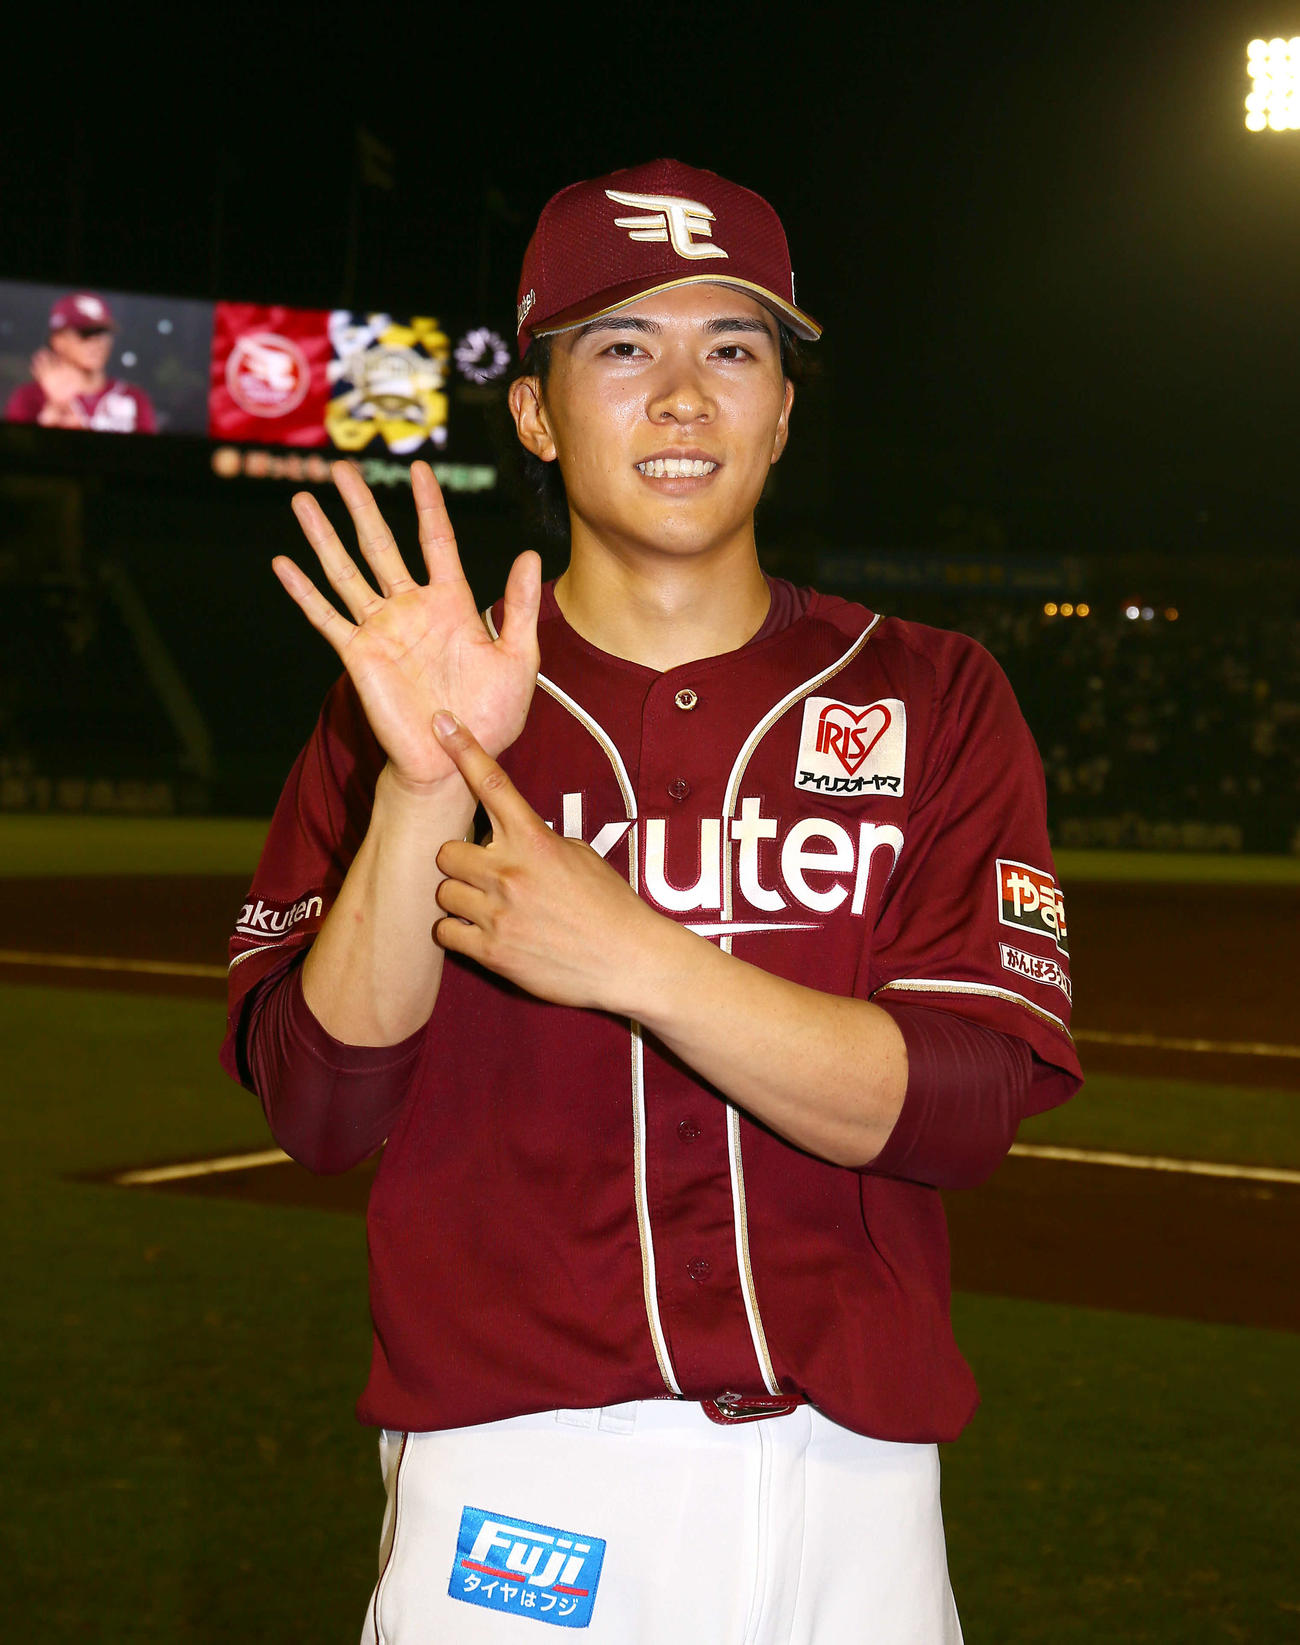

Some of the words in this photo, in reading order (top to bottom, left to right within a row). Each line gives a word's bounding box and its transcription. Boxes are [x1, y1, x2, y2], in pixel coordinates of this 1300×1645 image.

[816, 719, 867, 759] IRIS
[798, 770, 901, 793] アイリスオーヤマ
[545, 792, 905, 917] kuten
[468, 1519, 591, 1588] Fuji
[463, 1573, 579, 1617] タイヤはフジ
